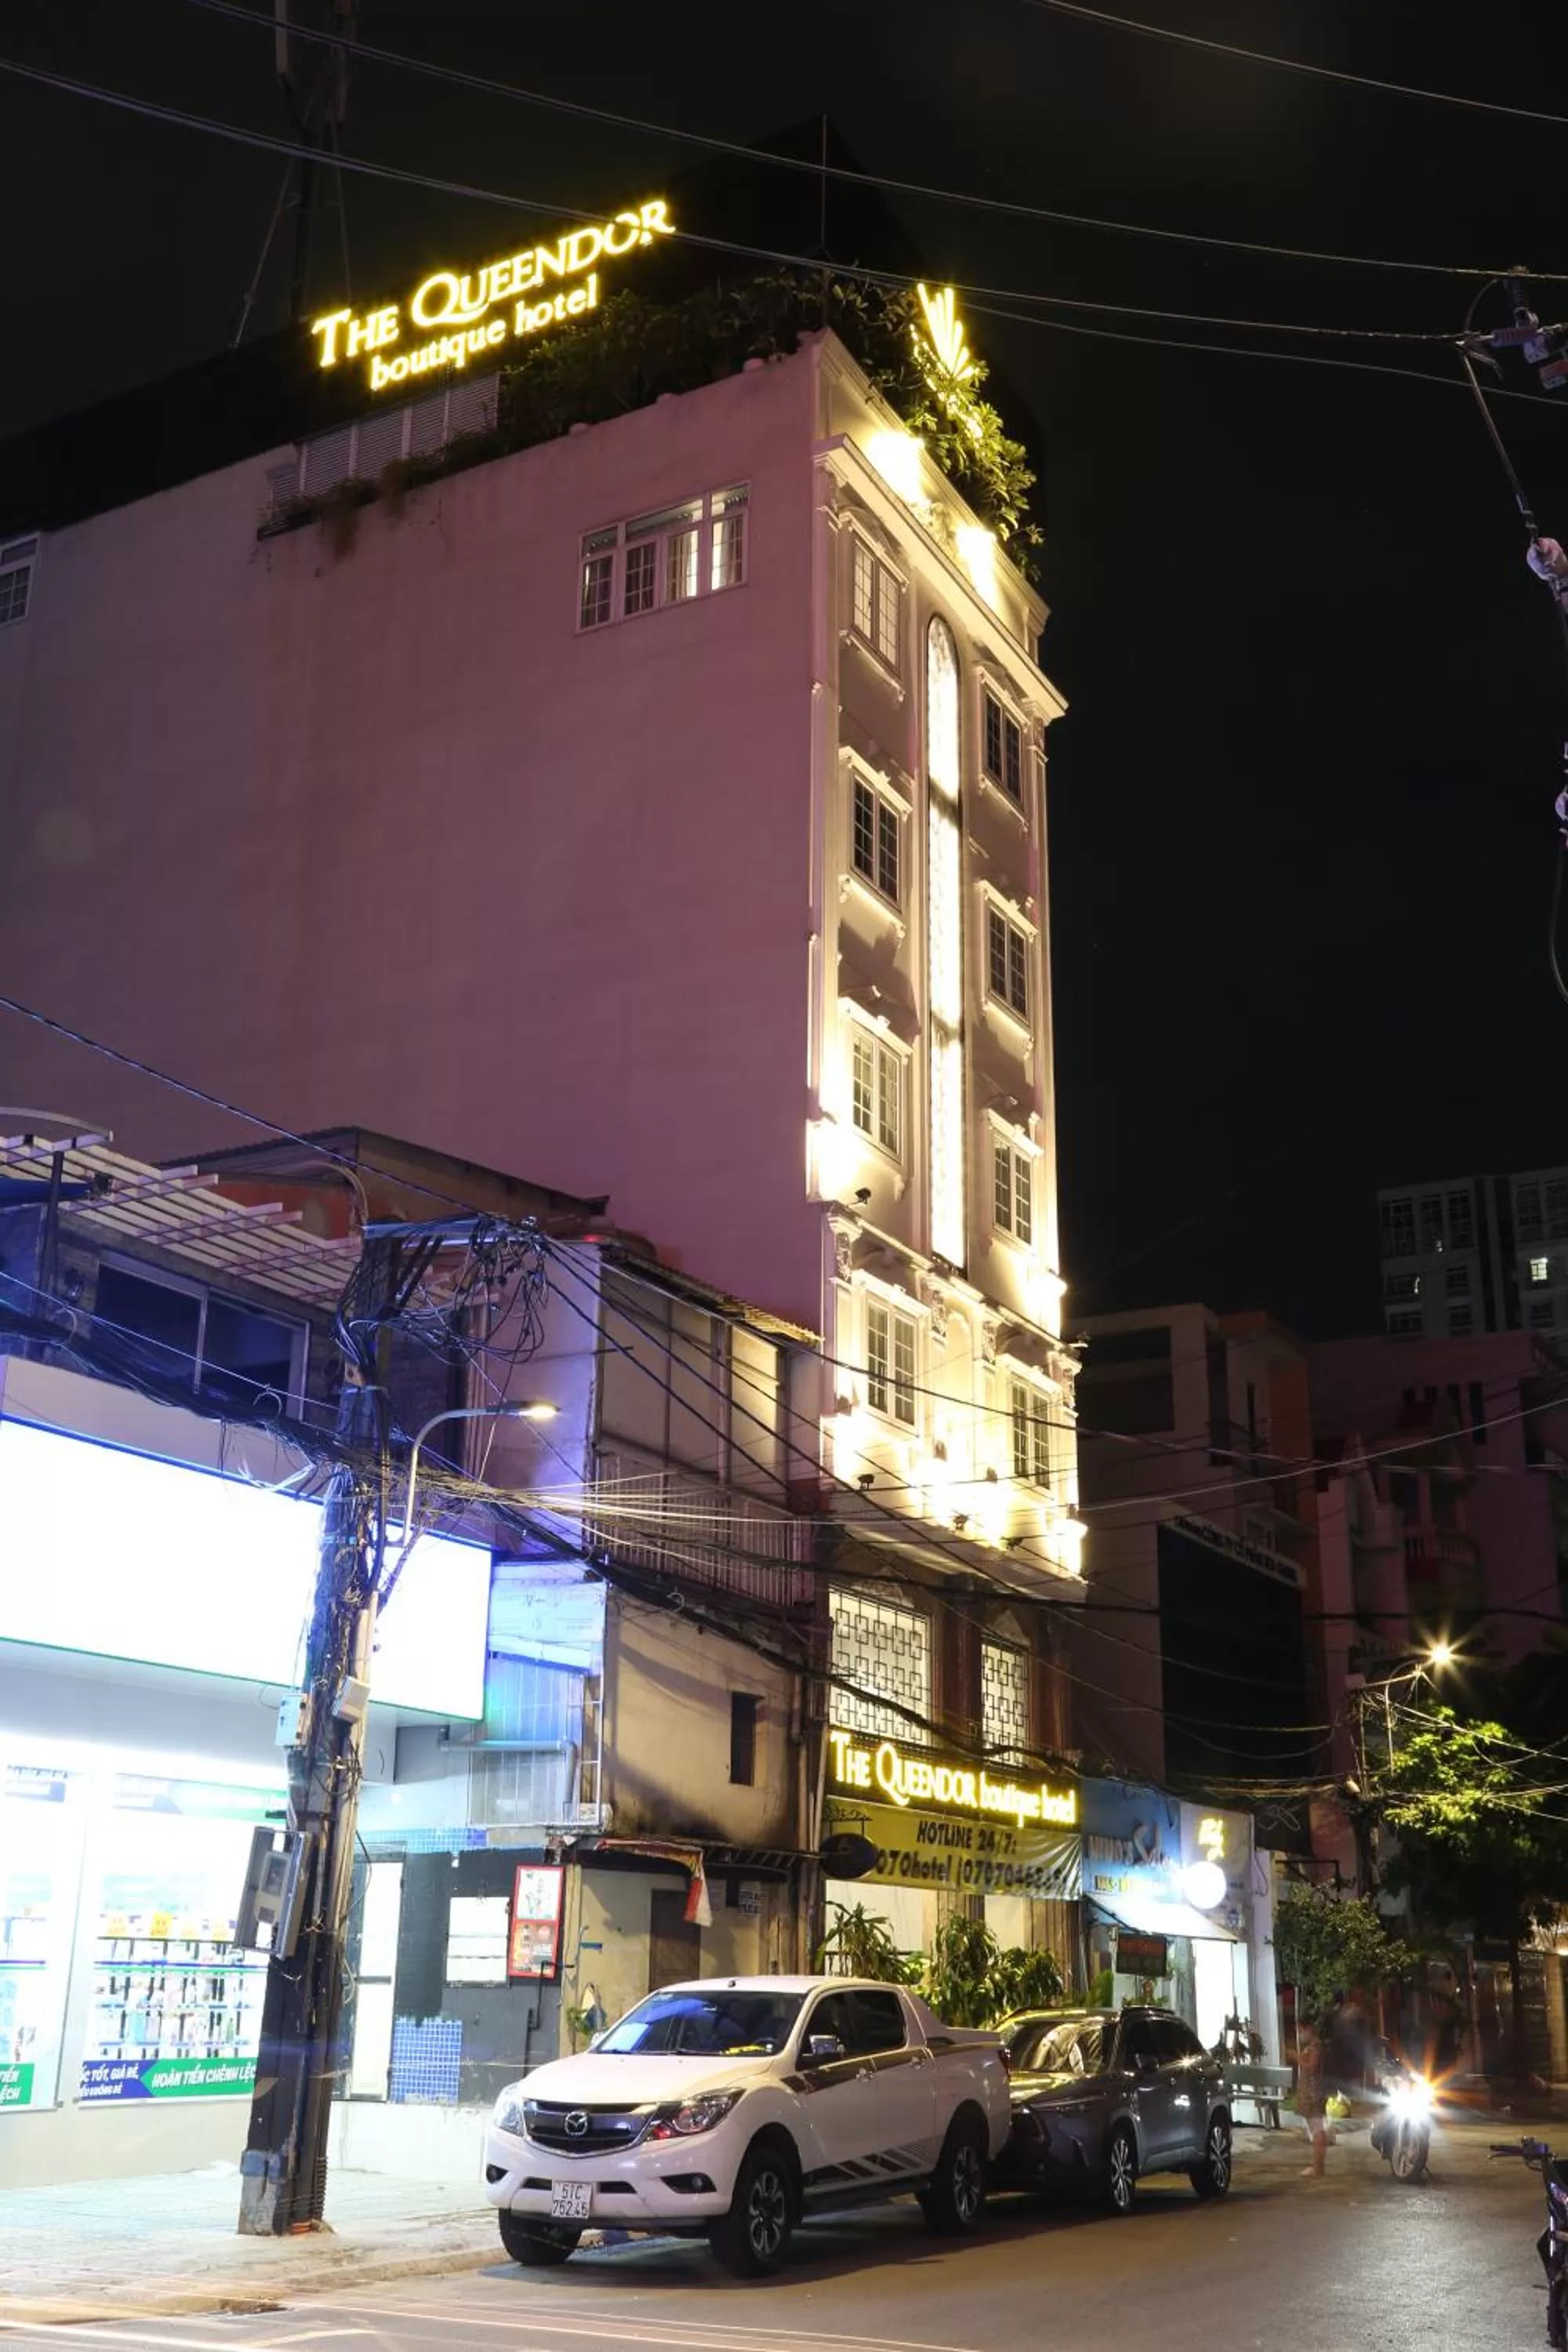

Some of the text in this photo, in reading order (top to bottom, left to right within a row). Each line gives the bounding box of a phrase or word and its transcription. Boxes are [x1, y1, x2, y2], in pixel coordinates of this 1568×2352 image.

[312, 199, 676, 368] THE QUEENDOR
[370, 274, 599, 392] boutique hotel
[829, 1730, 1076, 1829] THE QUEENDOR boutique hotel
[151, 2067, 183, 2089] HOÀN
[238, 2061, 257, 2083] LỆC
